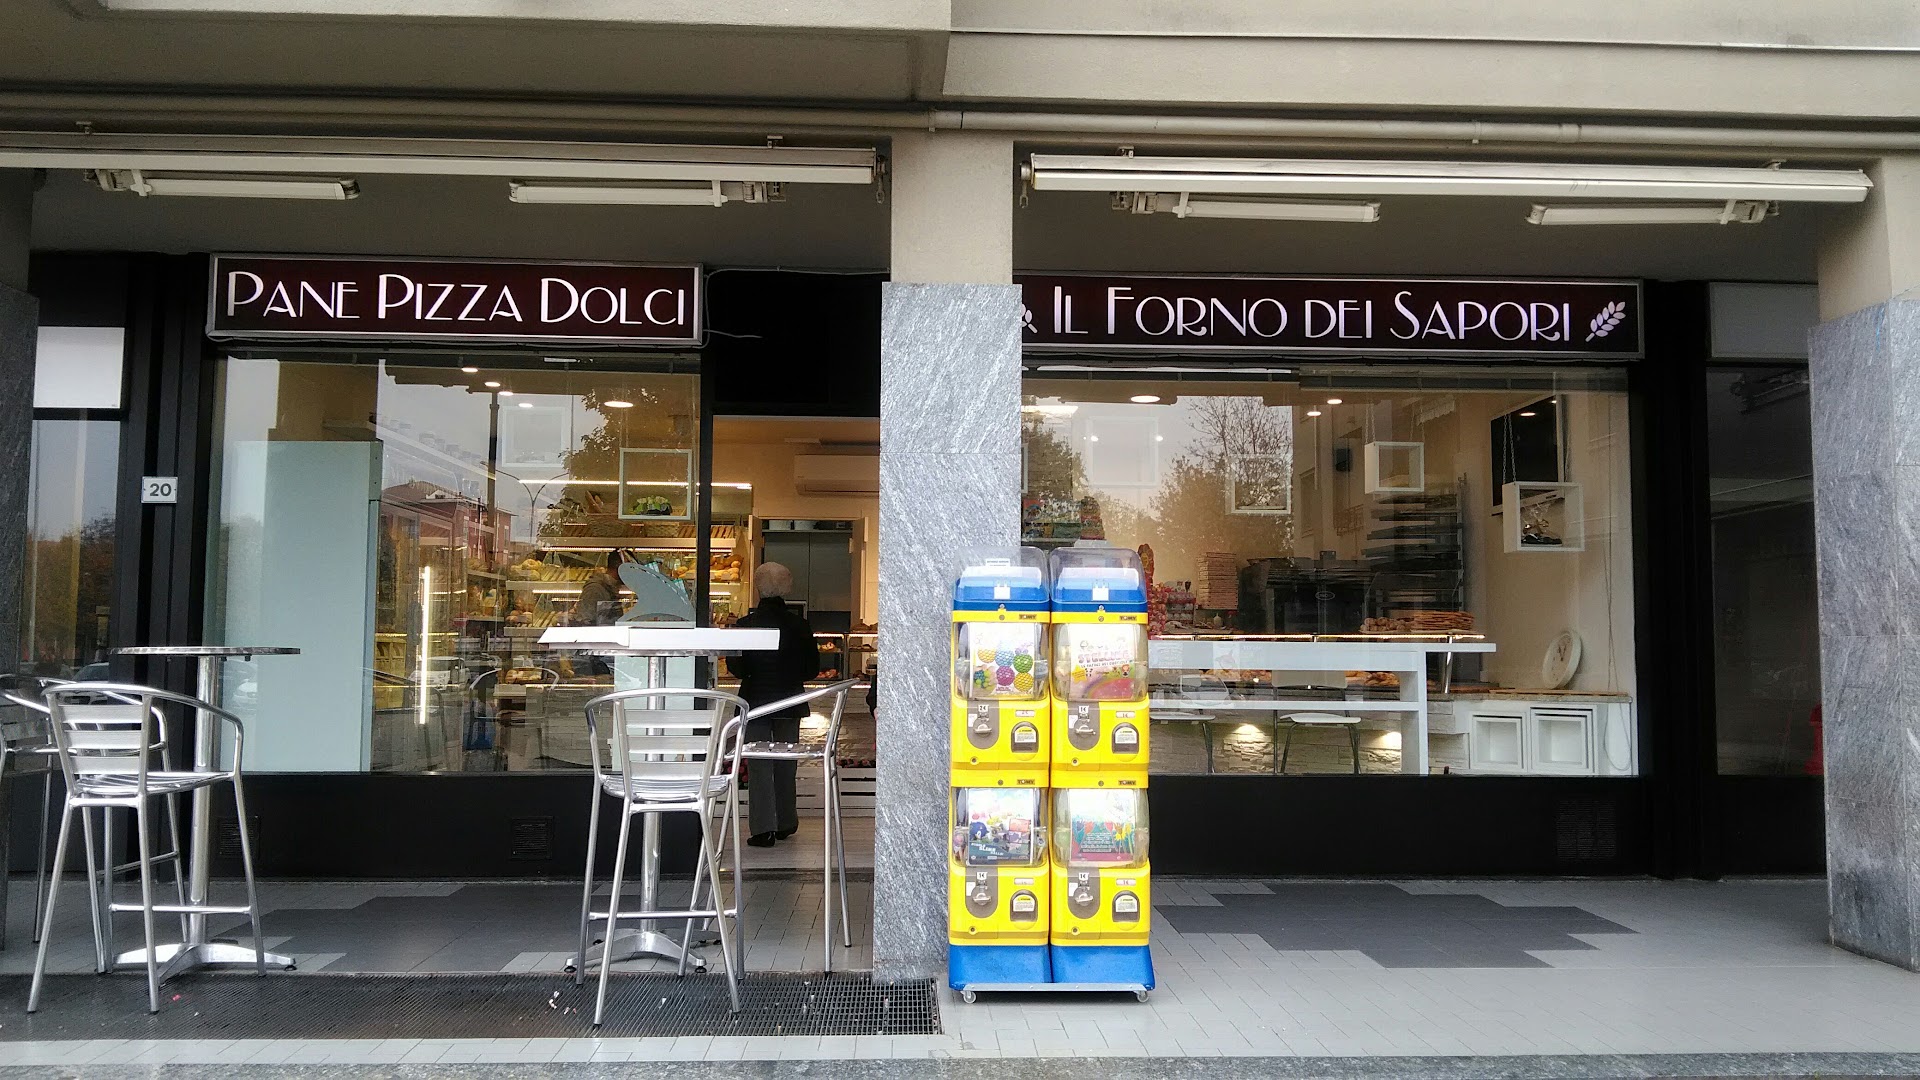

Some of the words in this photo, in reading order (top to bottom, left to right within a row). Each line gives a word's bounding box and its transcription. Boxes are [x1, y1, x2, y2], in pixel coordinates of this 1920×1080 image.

[227, 271, 361, 320] PANE
[377, 273, 523, 323] PIZZA
[540, 277, 685, 326] DOLCI
[1053, 285, 1089, 335] IL
[1106, 286, 1288, 339] FORNO
[1304, 299, 1372, 340] DEI
[1389, 289, 1570, 342] SAPORI
[149, 482, 172, 497] 20
